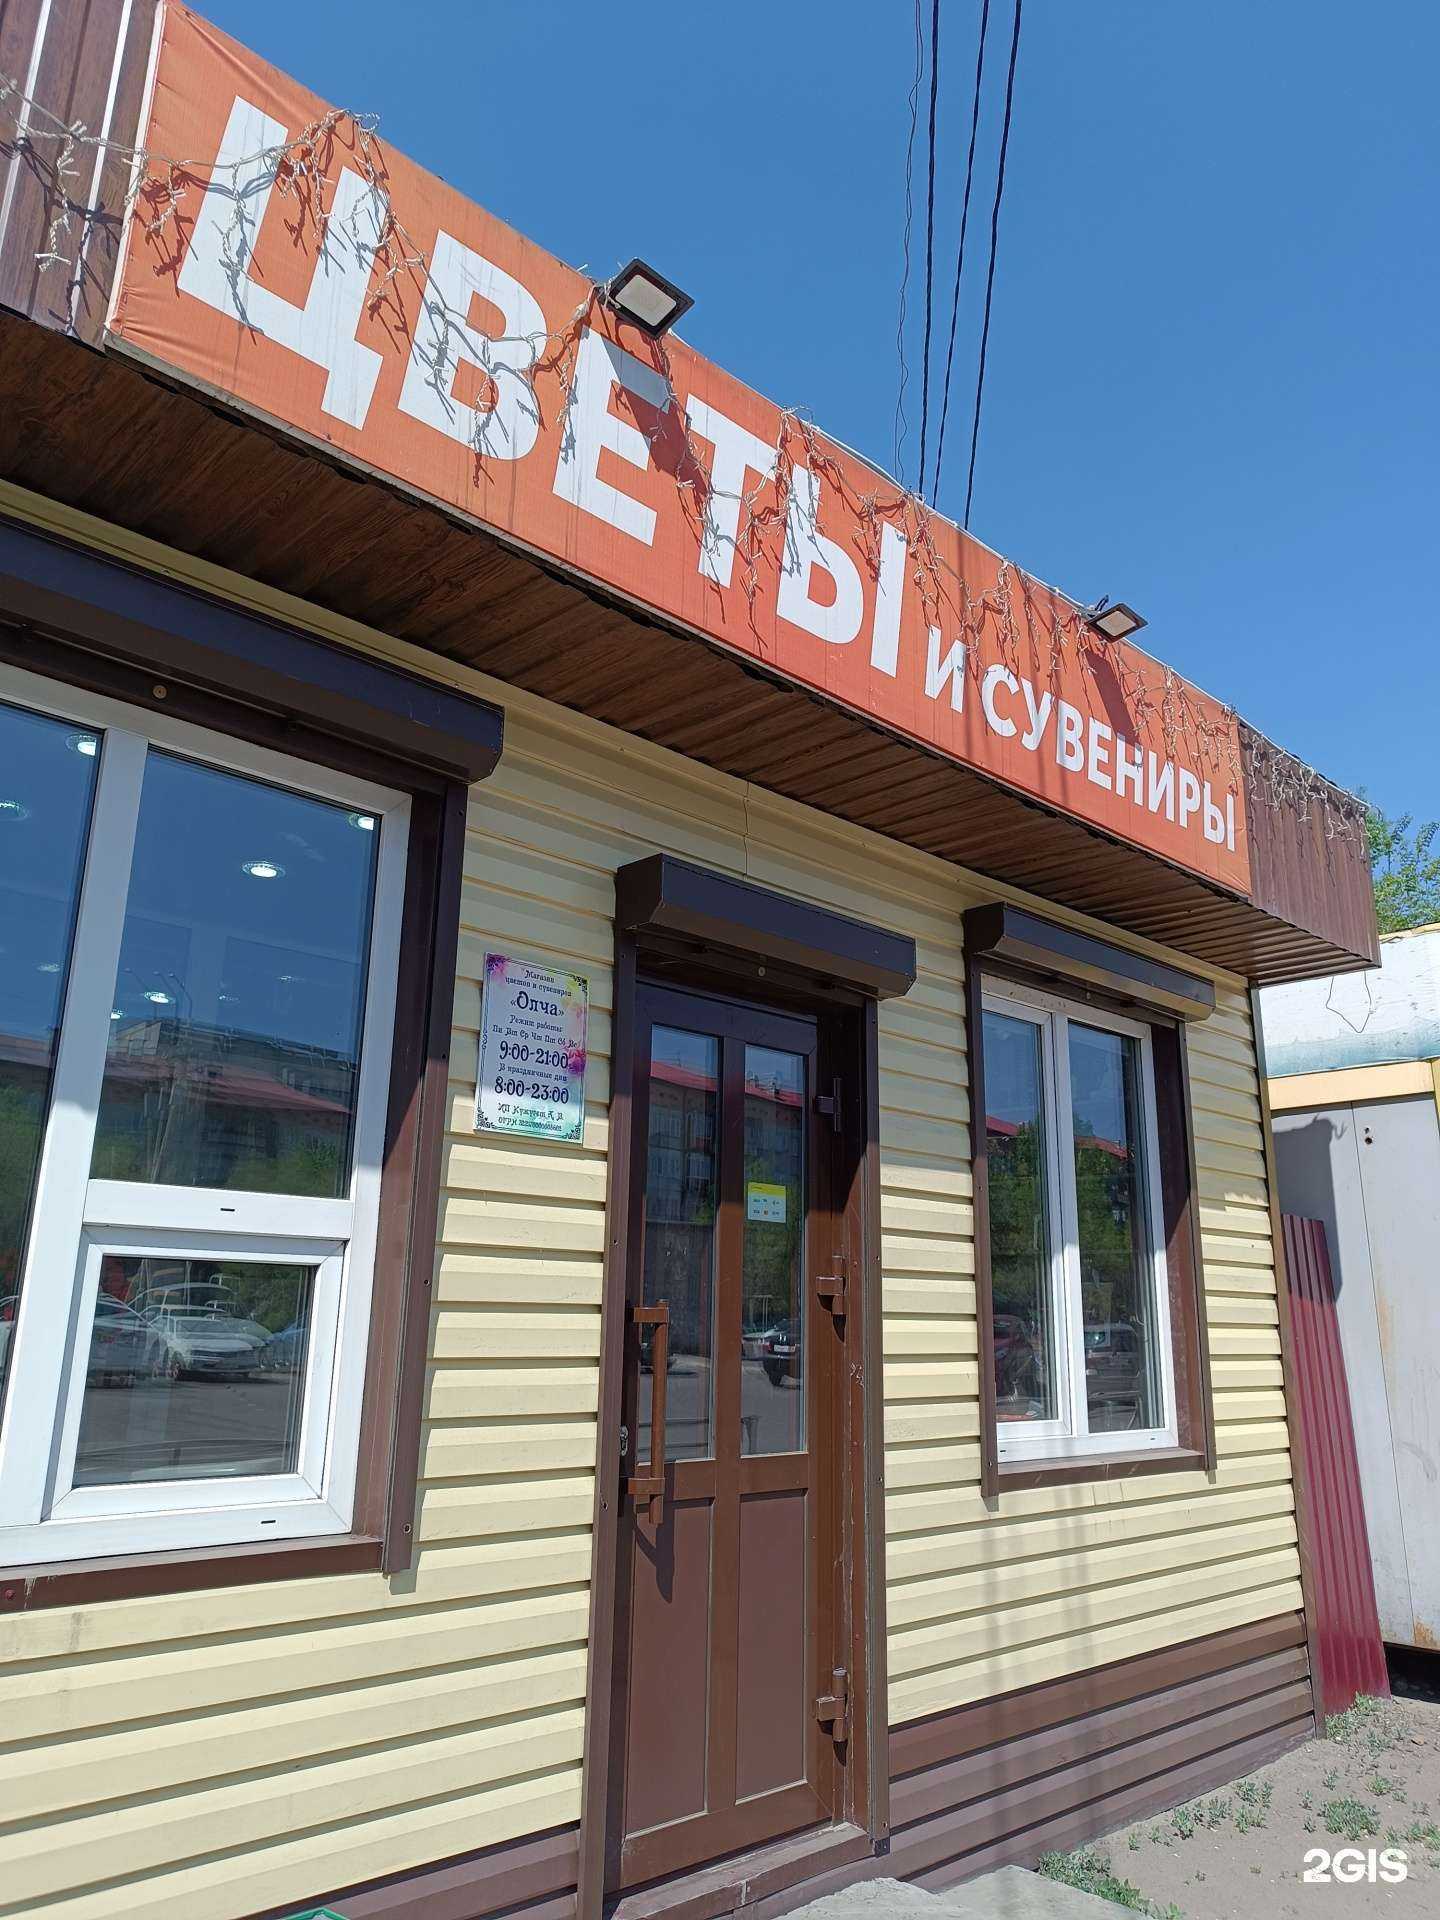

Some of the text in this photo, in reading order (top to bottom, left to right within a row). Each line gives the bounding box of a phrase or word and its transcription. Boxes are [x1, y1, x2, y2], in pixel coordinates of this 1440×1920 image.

[177, 95, 907, 678] ЦВЕТЫ
[981, 663, 1236, 853] СУВЕНИРЫ
[524, 969, 555, 983] Магазин
[510, 990, 564, 1016] «Олча»
[509, 1014, 535, 1026] Режим
[492, 1024, 503, 1033] Пн
[504, 1027, 518, 1036] Вт
[519, 1030, 529, 1040] Ср
[531, 1031, 542, 1041] Чт
[544, 1034, 556, 1044] Пт
[499, 1040, 569, 1069] 9:00-21:00
[498, 1062, 506, 1072] В
[494, 1075, 569, 1104] 8:00-23:00
